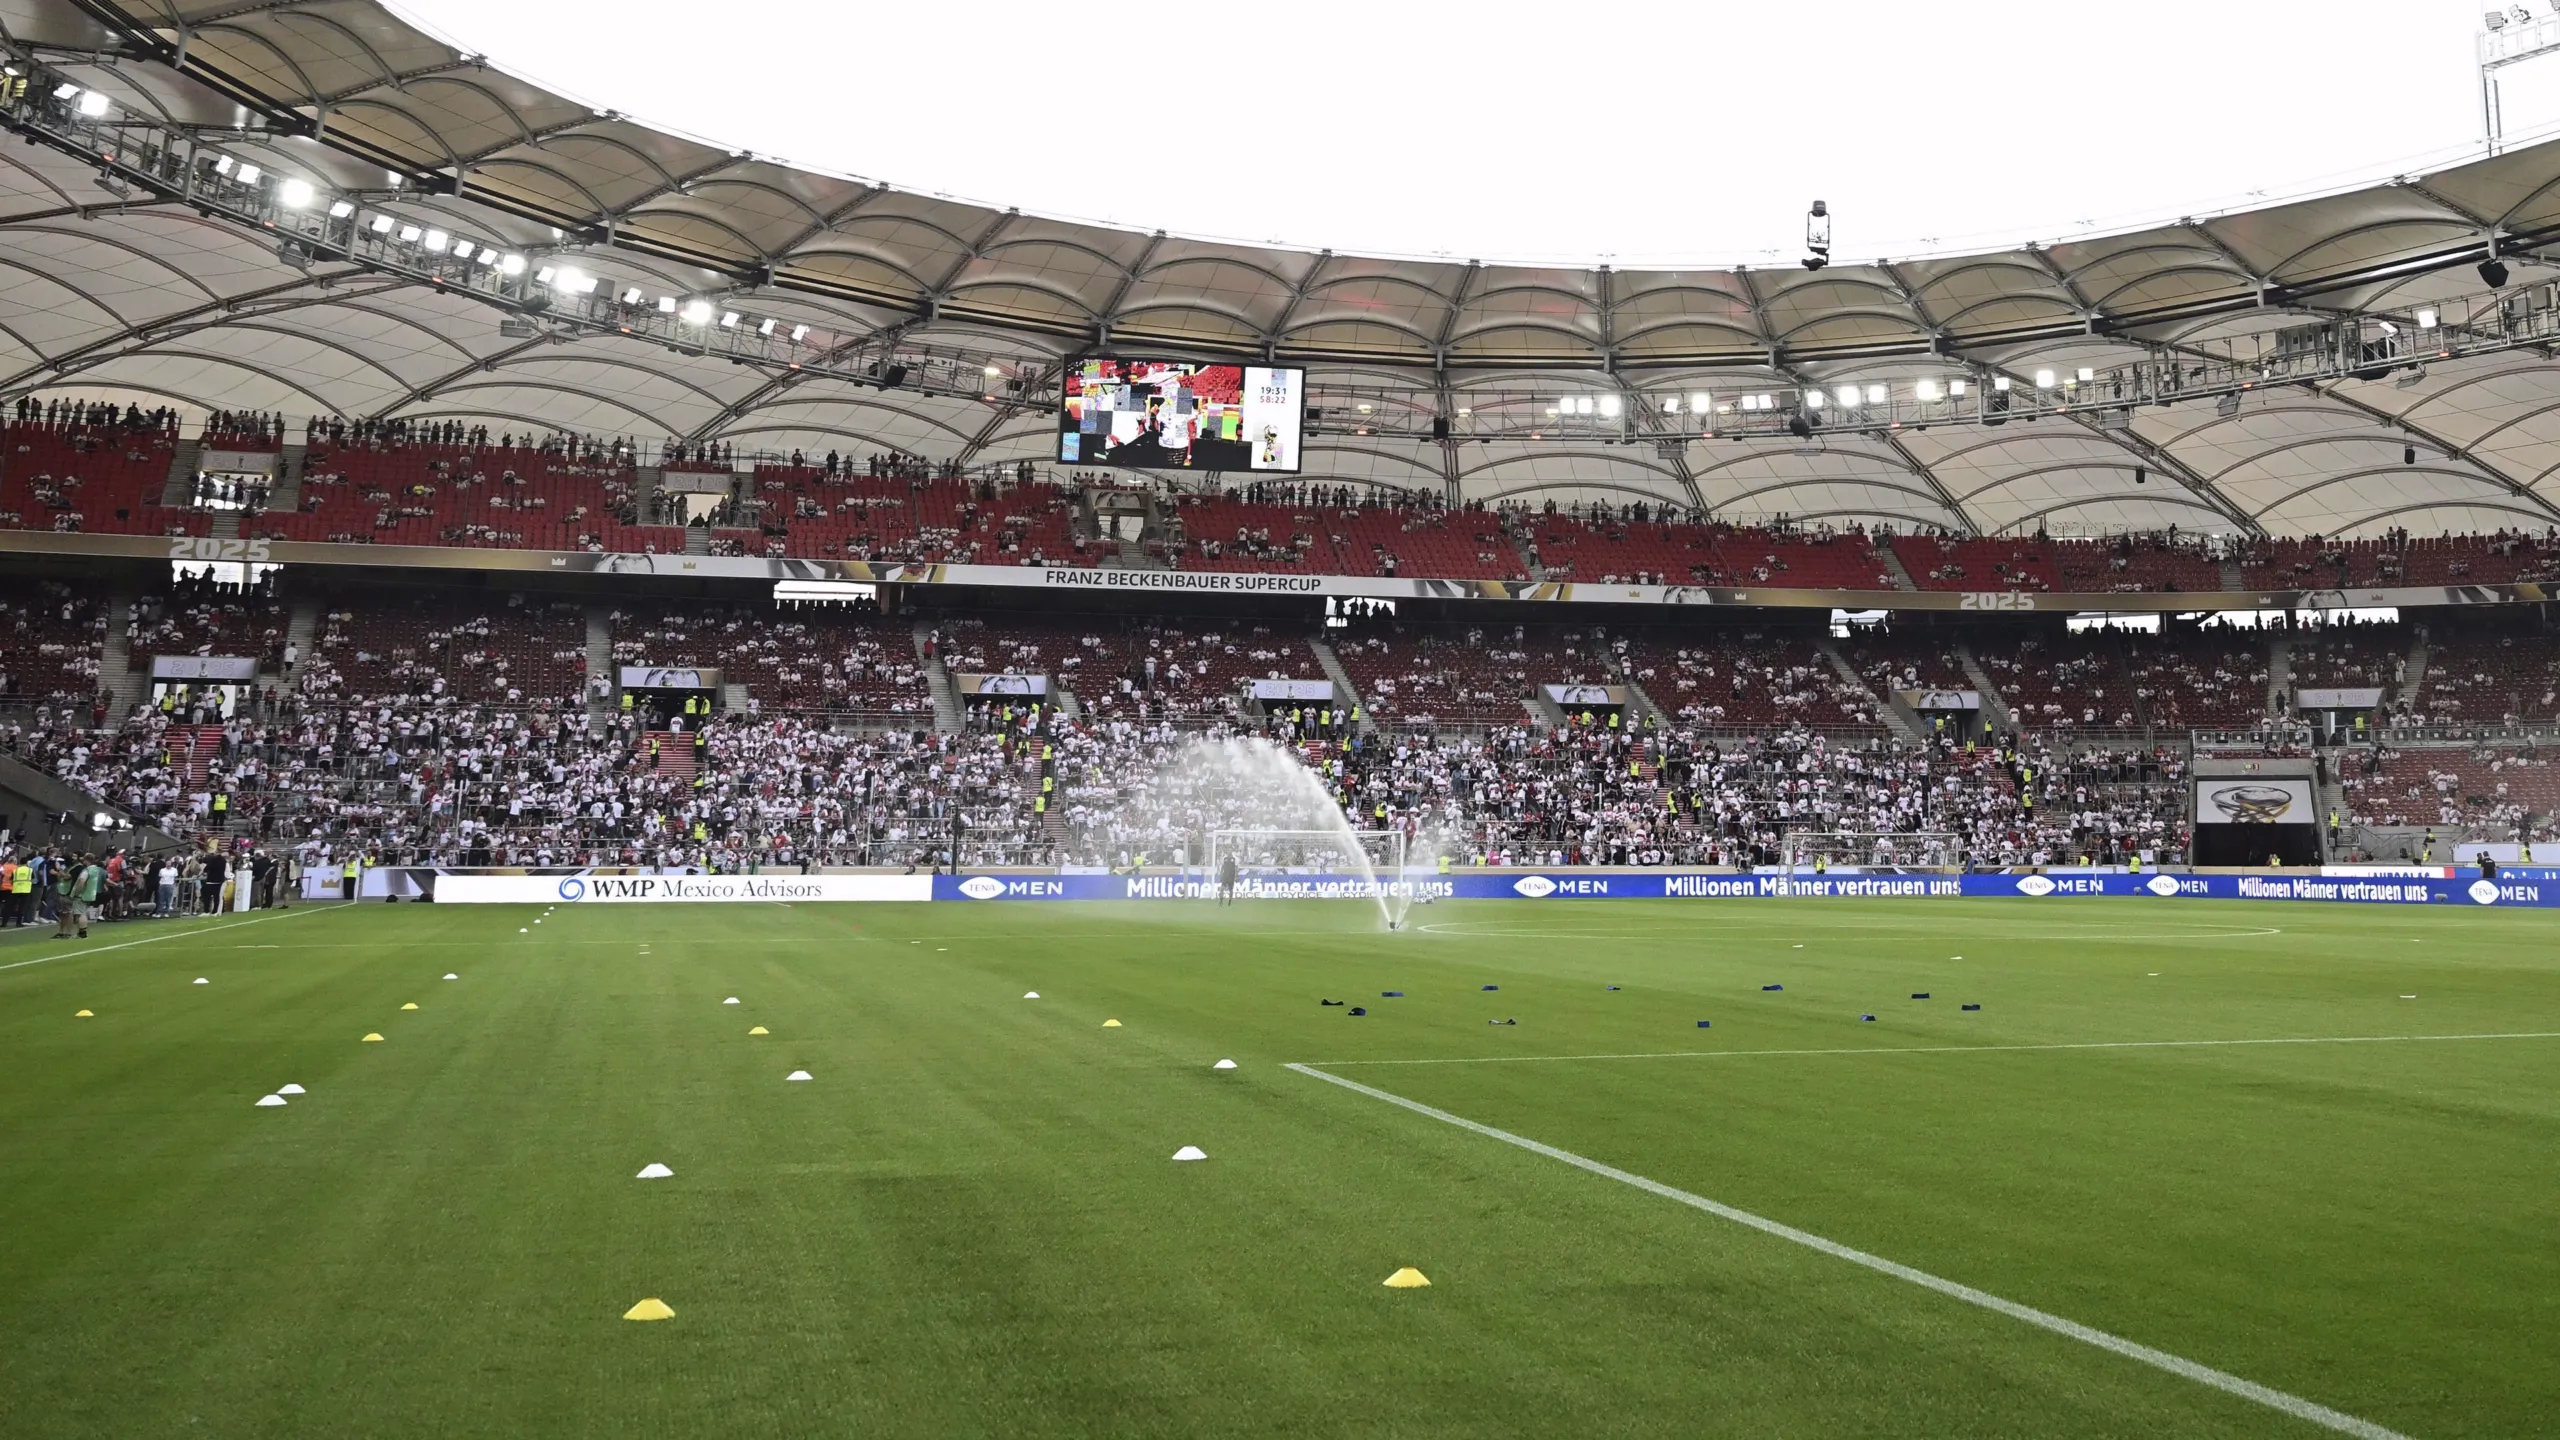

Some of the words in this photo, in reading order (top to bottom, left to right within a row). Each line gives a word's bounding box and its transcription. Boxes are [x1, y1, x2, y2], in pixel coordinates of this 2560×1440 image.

[1261, 386, 1286, 395] 19:31
[1260, 395, 1286, 404] 58:22
[169, 538, 270, 561] 2025
[1046, 570, 1103, 586] FRANZ
[1107, 572, 1231, 589] BECKENBAUER
[1235, 576, 1321, 592] SUPERCUP
[1960, 592, 2035, 610] 2025
[593, 880, 655, 897] WMP
[662, 880, 734, 898] Mexico
[740, 879, 822, 898] Advisors
[969, 883, 996, 892] TENA
[1009, 881, 1063, 895] MEN
[1523, 882, 1547, 890] TENA
[1559, 880, 1608, 894] MEN
[1665, 876, 1754, 896] Millionen
[1760, 877, 1832, 896] Männer
[1836, 878, 1925, 895] vertrauen
[1930, 880, 1961, 895] uns
[2058, 879, 2104, 892] MEN
[2181, 880, 2209, 893] MEN
[2238, 877, 2291, 898] Millionen
[2293, 879, 2339, 900] Männer
[2340, 881, 2401, 901] vertrauen
[2404, 885, 2428, 902] uns
[2501, 885, 2539, 901] MEN
[1341, 890, 1381, 898] ICYDIC
